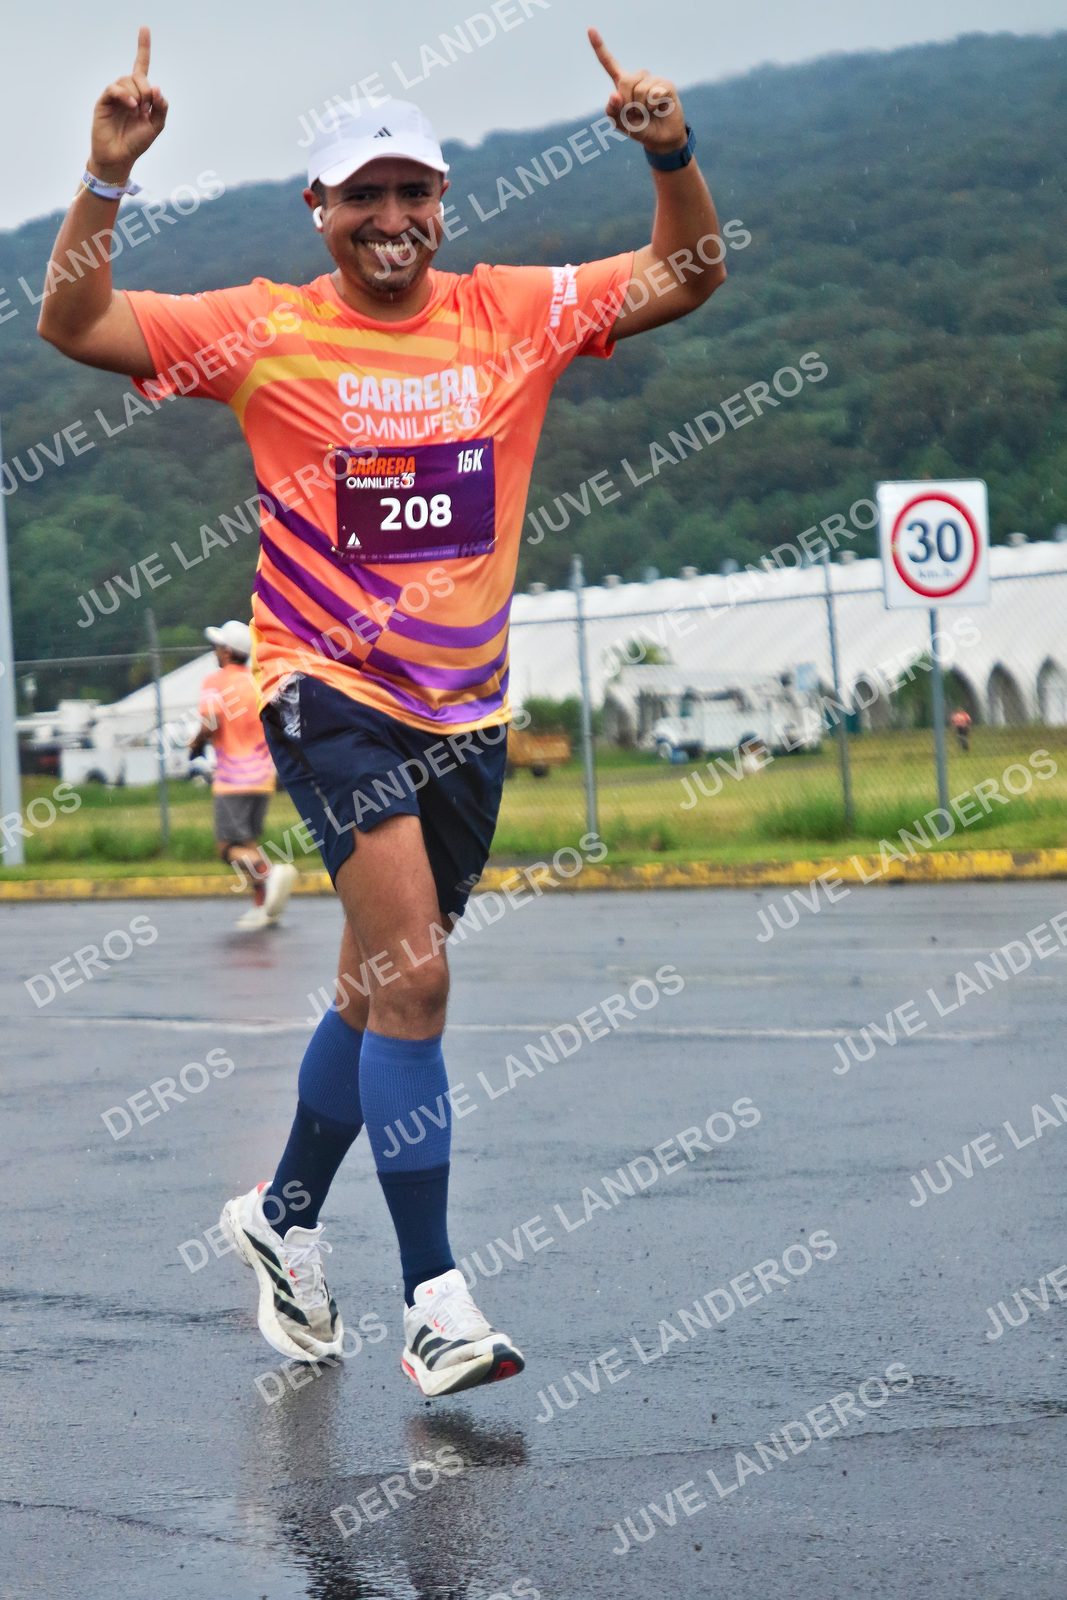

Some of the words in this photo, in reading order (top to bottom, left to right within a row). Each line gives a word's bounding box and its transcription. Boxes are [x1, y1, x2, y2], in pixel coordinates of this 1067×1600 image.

[338, 365, 478, 412] CARRERA
[341, 410, 454, 441] OMNILIFE
[348, 456, 416, 476] CARRERA
[457, 448, 484, 474] 15K
[345, 475, 400, 489] OMNILIFE
[379, 493, 453, 531] 208
[907, 519, 962, 563] 30
